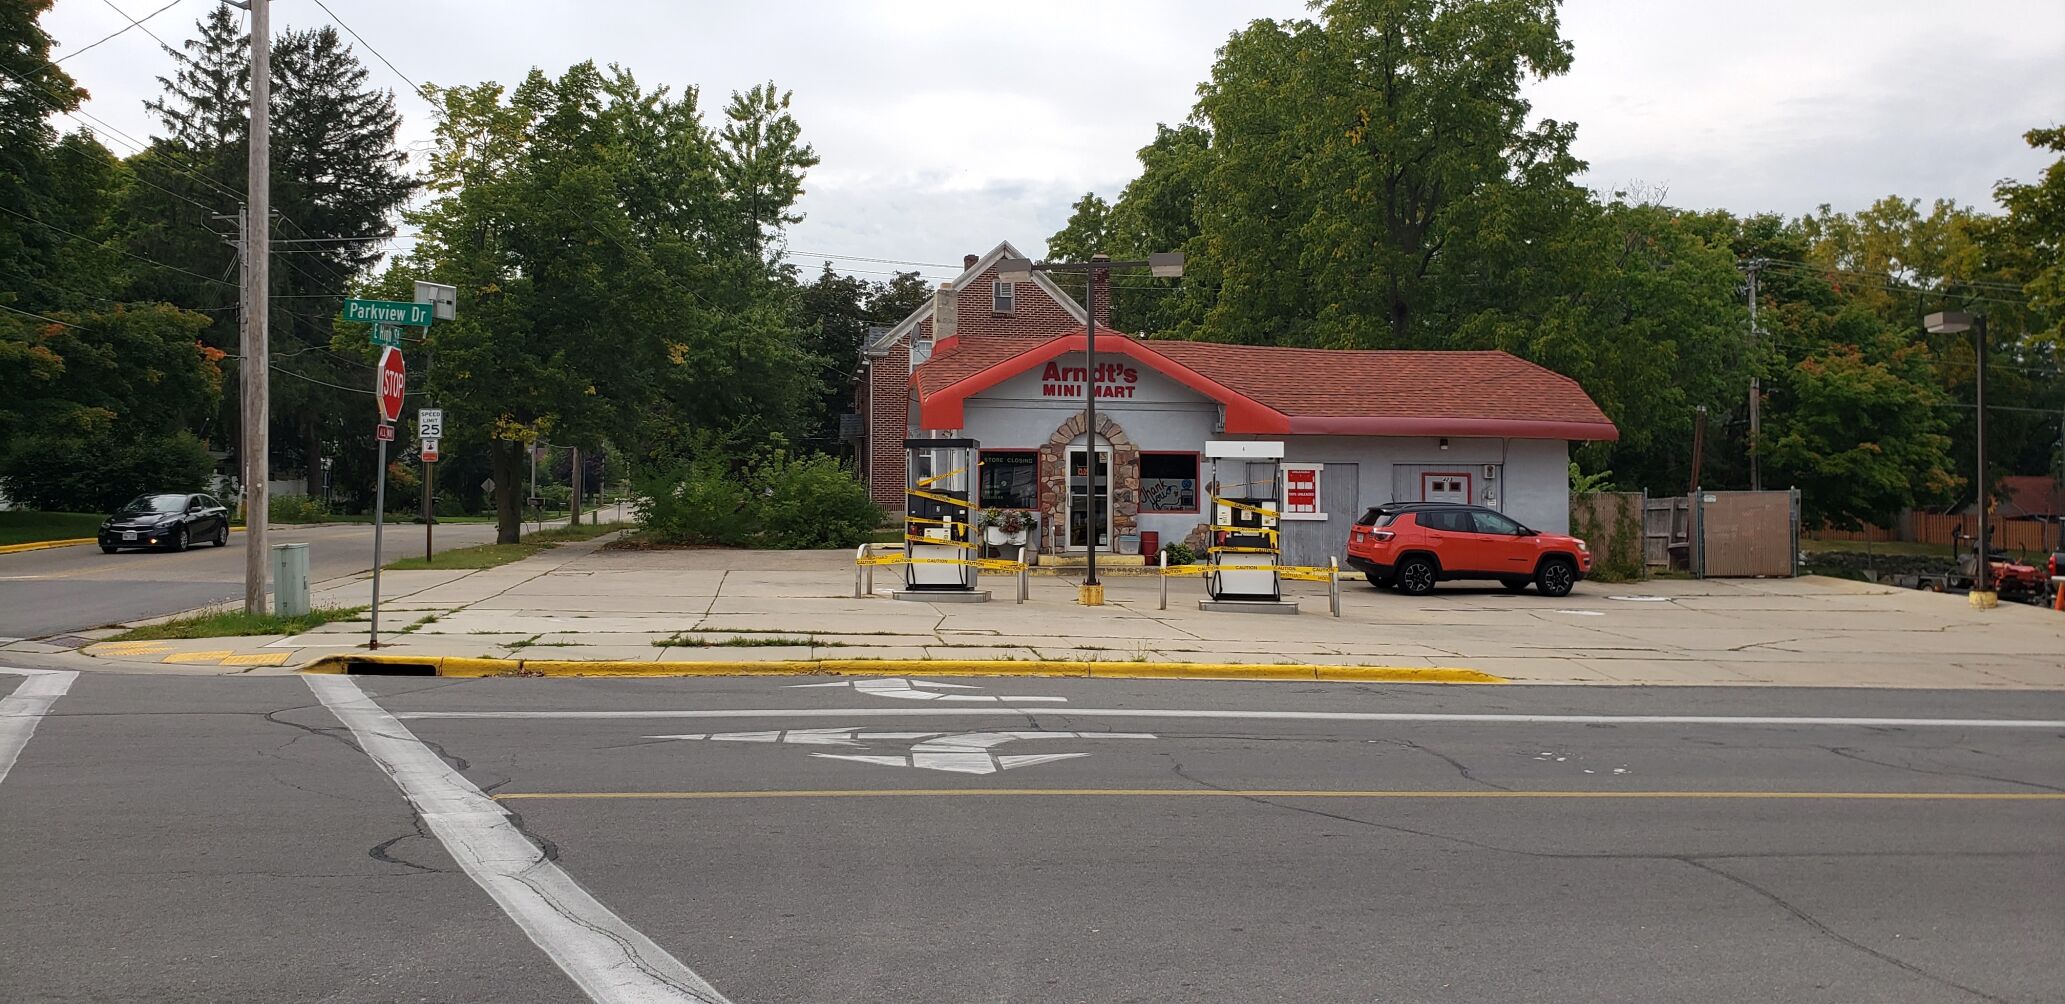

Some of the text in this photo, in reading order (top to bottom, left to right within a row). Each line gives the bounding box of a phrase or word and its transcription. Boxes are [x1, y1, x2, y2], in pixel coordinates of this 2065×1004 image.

[349, 302, 427, 322] Parkview Dr
[374, 323, 378, 339] E
[380, 324, 392, 344] High
[1042, 361, 1138, 383] Arndt's
[384, 369, 404, 398] STOP
[1043, 384, 1081, 397] MINI
[421, 425, 440, 435] 25
[1234, 503, 1256, 511] CAUTION
